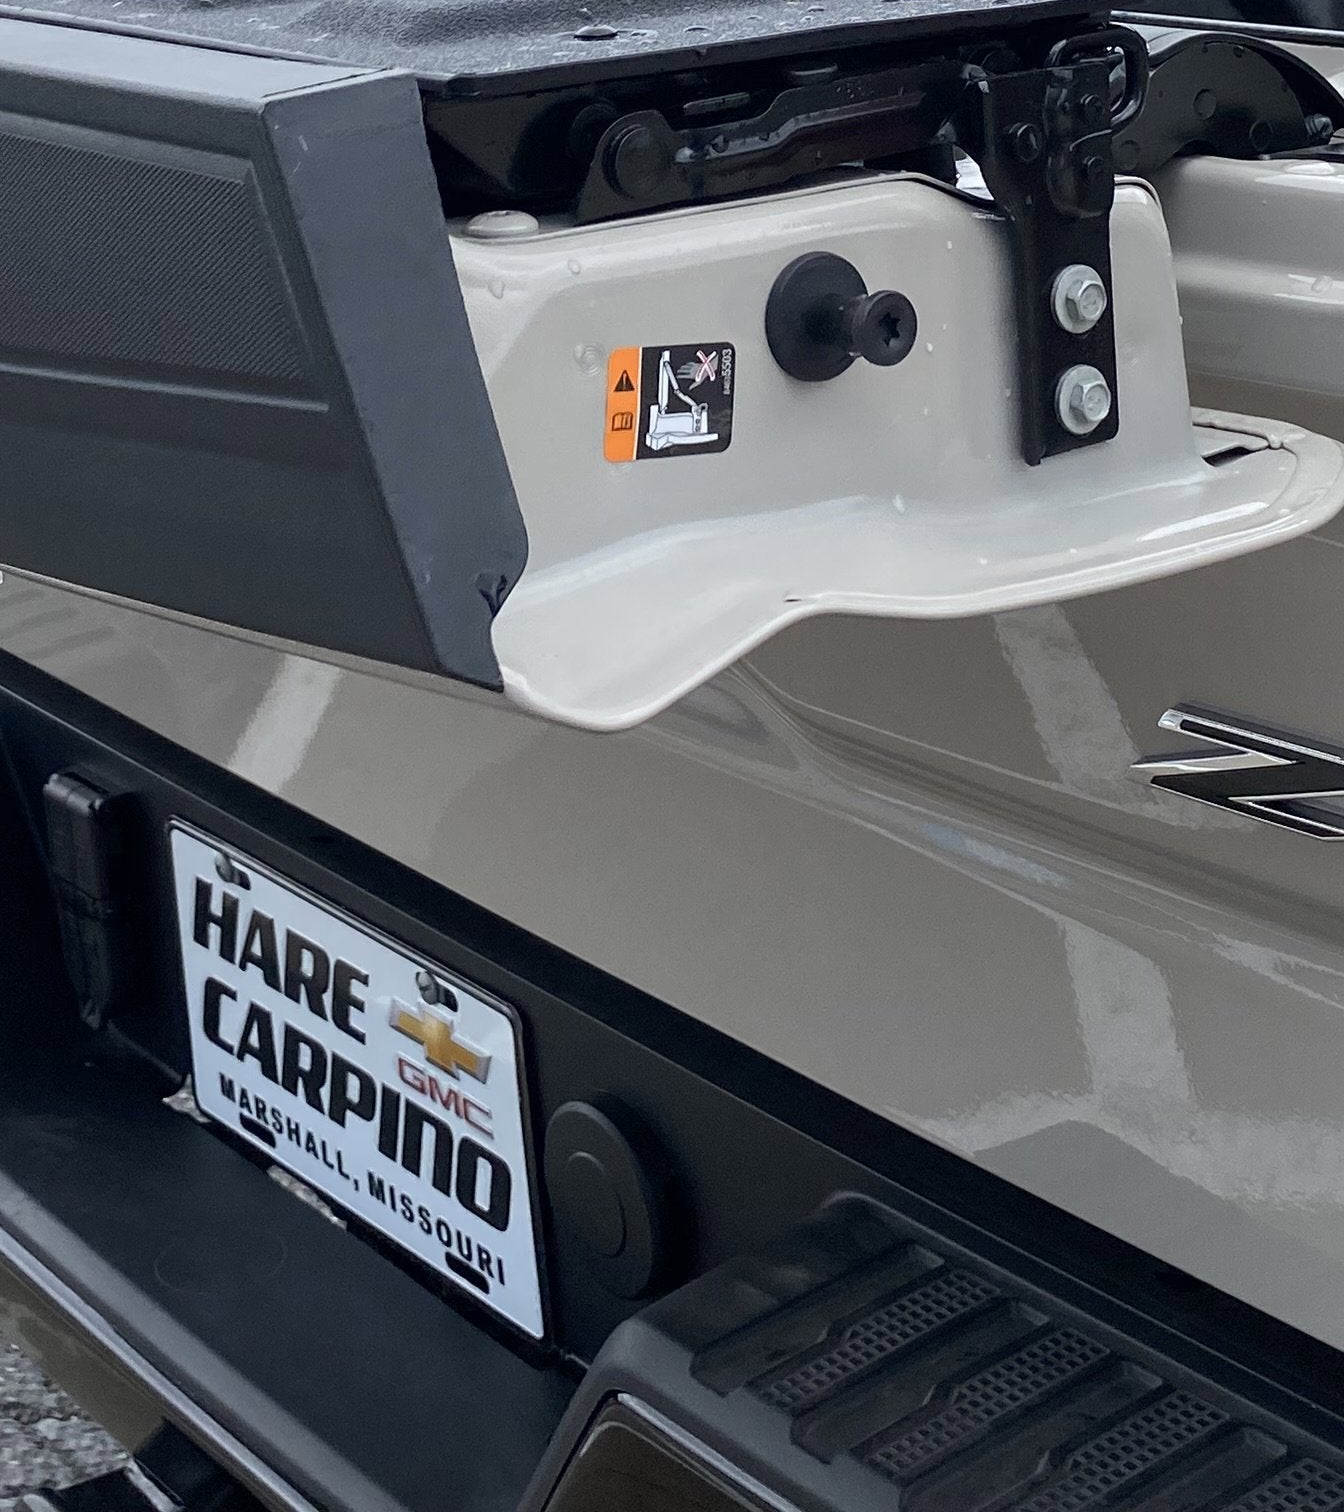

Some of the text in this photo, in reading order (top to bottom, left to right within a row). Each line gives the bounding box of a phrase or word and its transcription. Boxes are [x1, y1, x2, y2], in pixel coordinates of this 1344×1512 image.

[193, 876, 370, 1046] HARE
[202, 975, 512, 1232] CARPINO
[397, 1055, 495, 1140] GMC
[366, 1169, 506, 1287] MISSOURI
